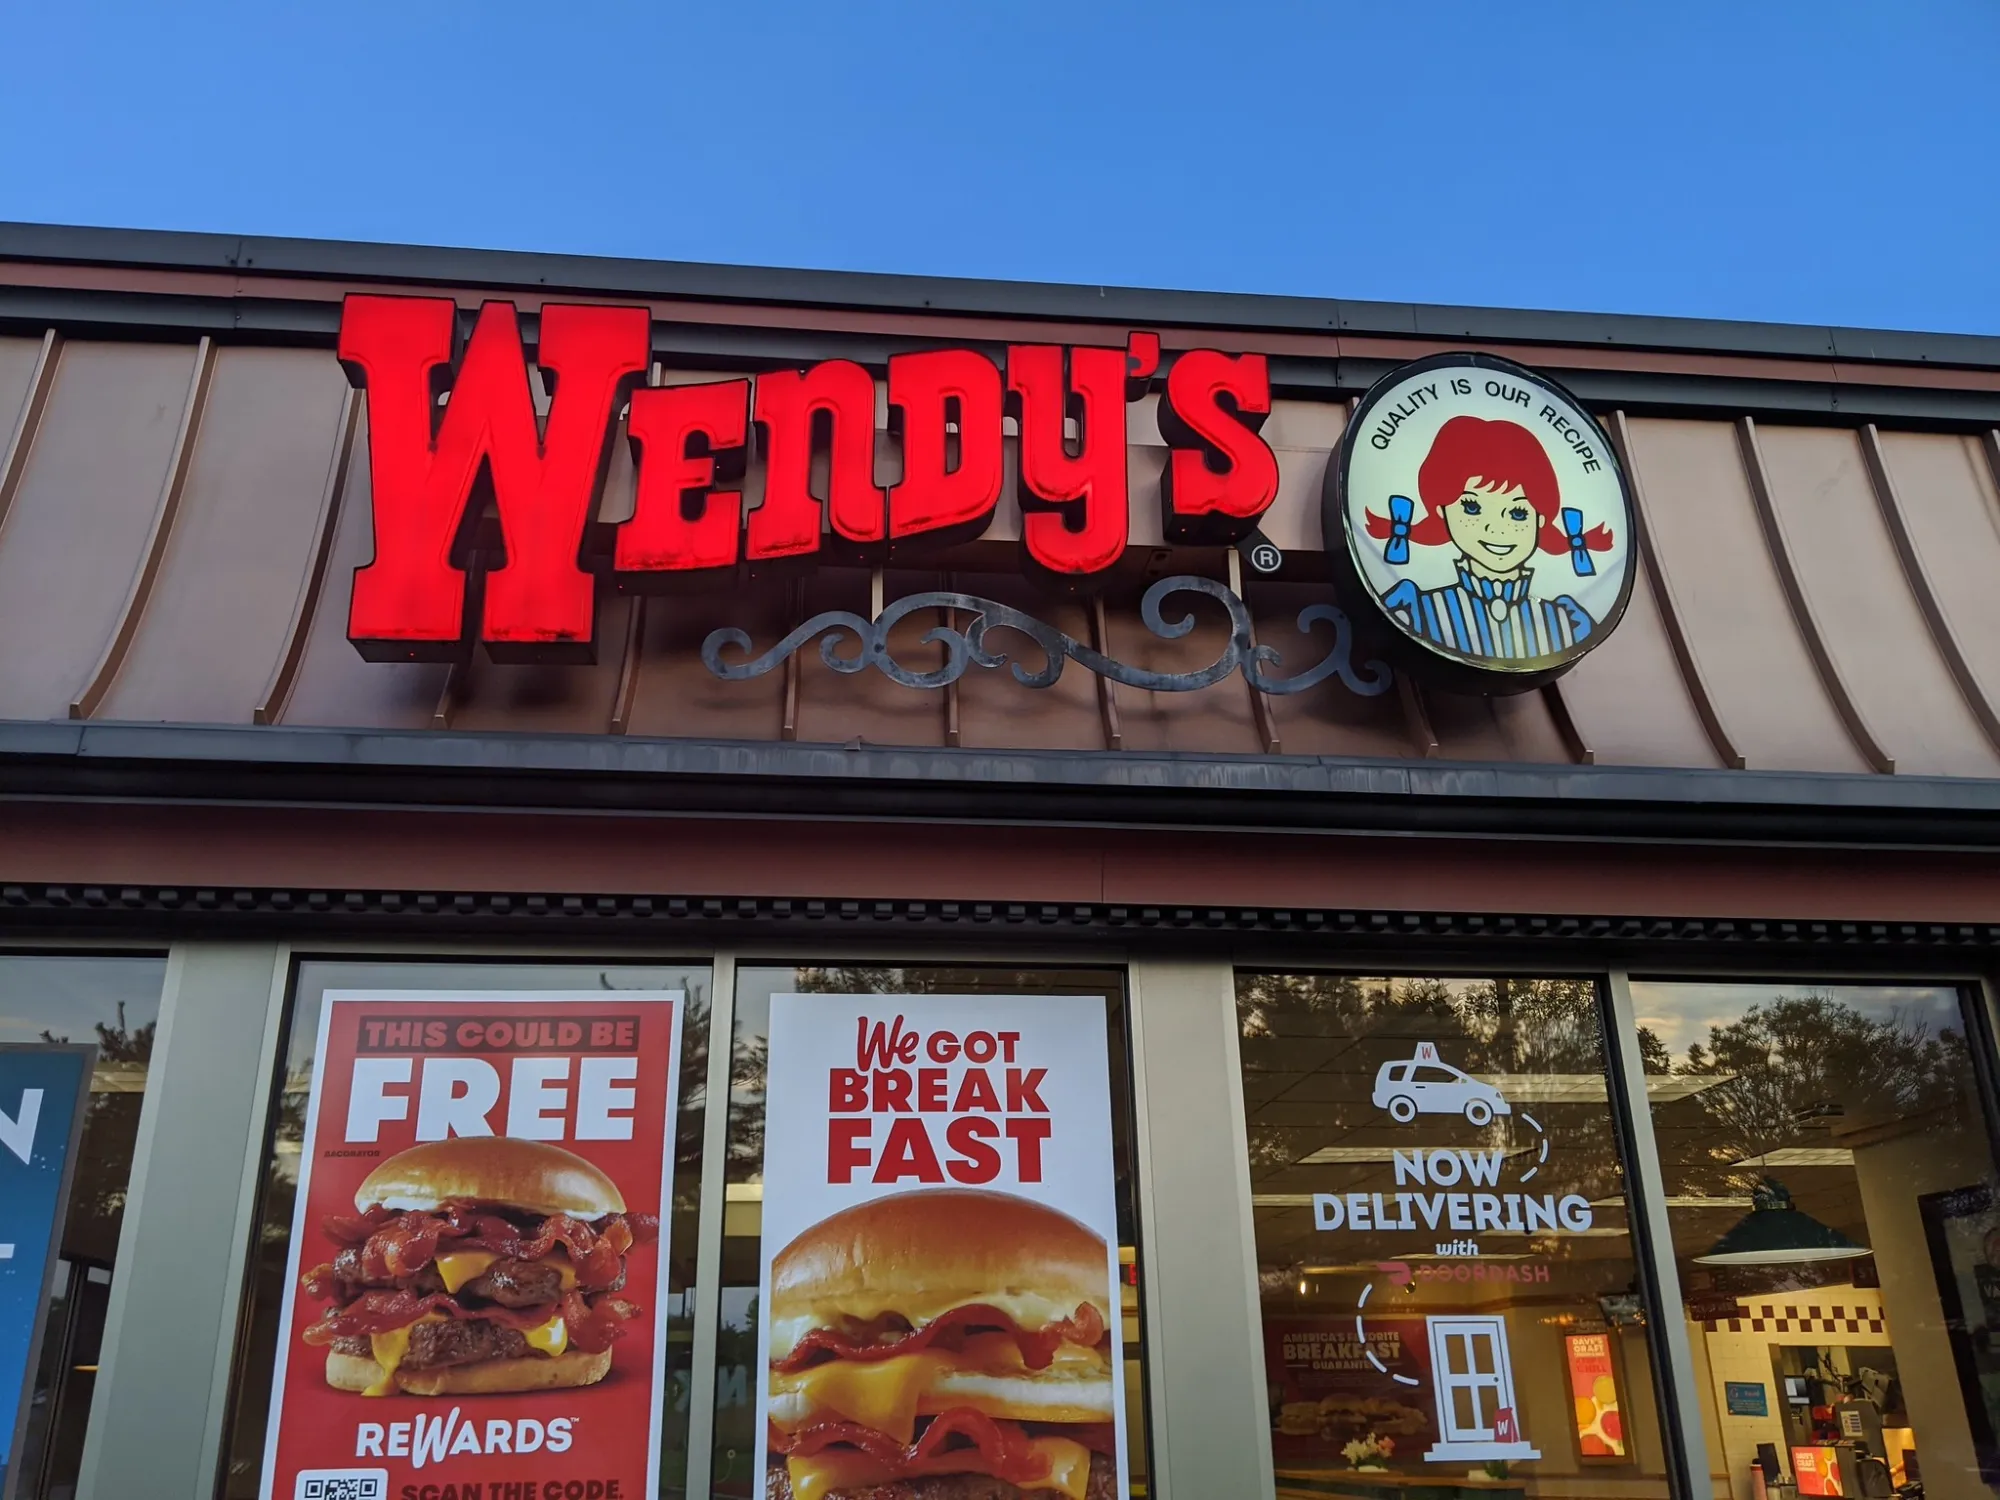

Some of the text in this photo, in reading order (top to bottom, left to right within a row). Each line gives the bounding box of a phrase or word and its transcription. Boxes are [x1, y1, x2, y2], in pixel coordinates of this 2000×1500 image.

[1371, 378, 1602, 475] QUALITY IS OUR RECIPE
[365, 1021, 635, 1048] THIS COULD BE
[857, 1014, 1020, 1072] We GOT
[345, 1057, 639, 1142] FREE
[829, 1068, 1050, 1113] BREAK
[827, 1115, 1052, 1185] FAST
[1393, 1150, 1503, 1187] NOW
[1312, 1193, 1593, 1233] DELIVERING
[1436, 1239, 1479, 1256] with
[1420, 1264, 1550, 1283] DOORDASH
[1283, 1342, 1400, 1359] BREAKFAST
[401, 1479, 624, 1500] SCAN THE CODE.
